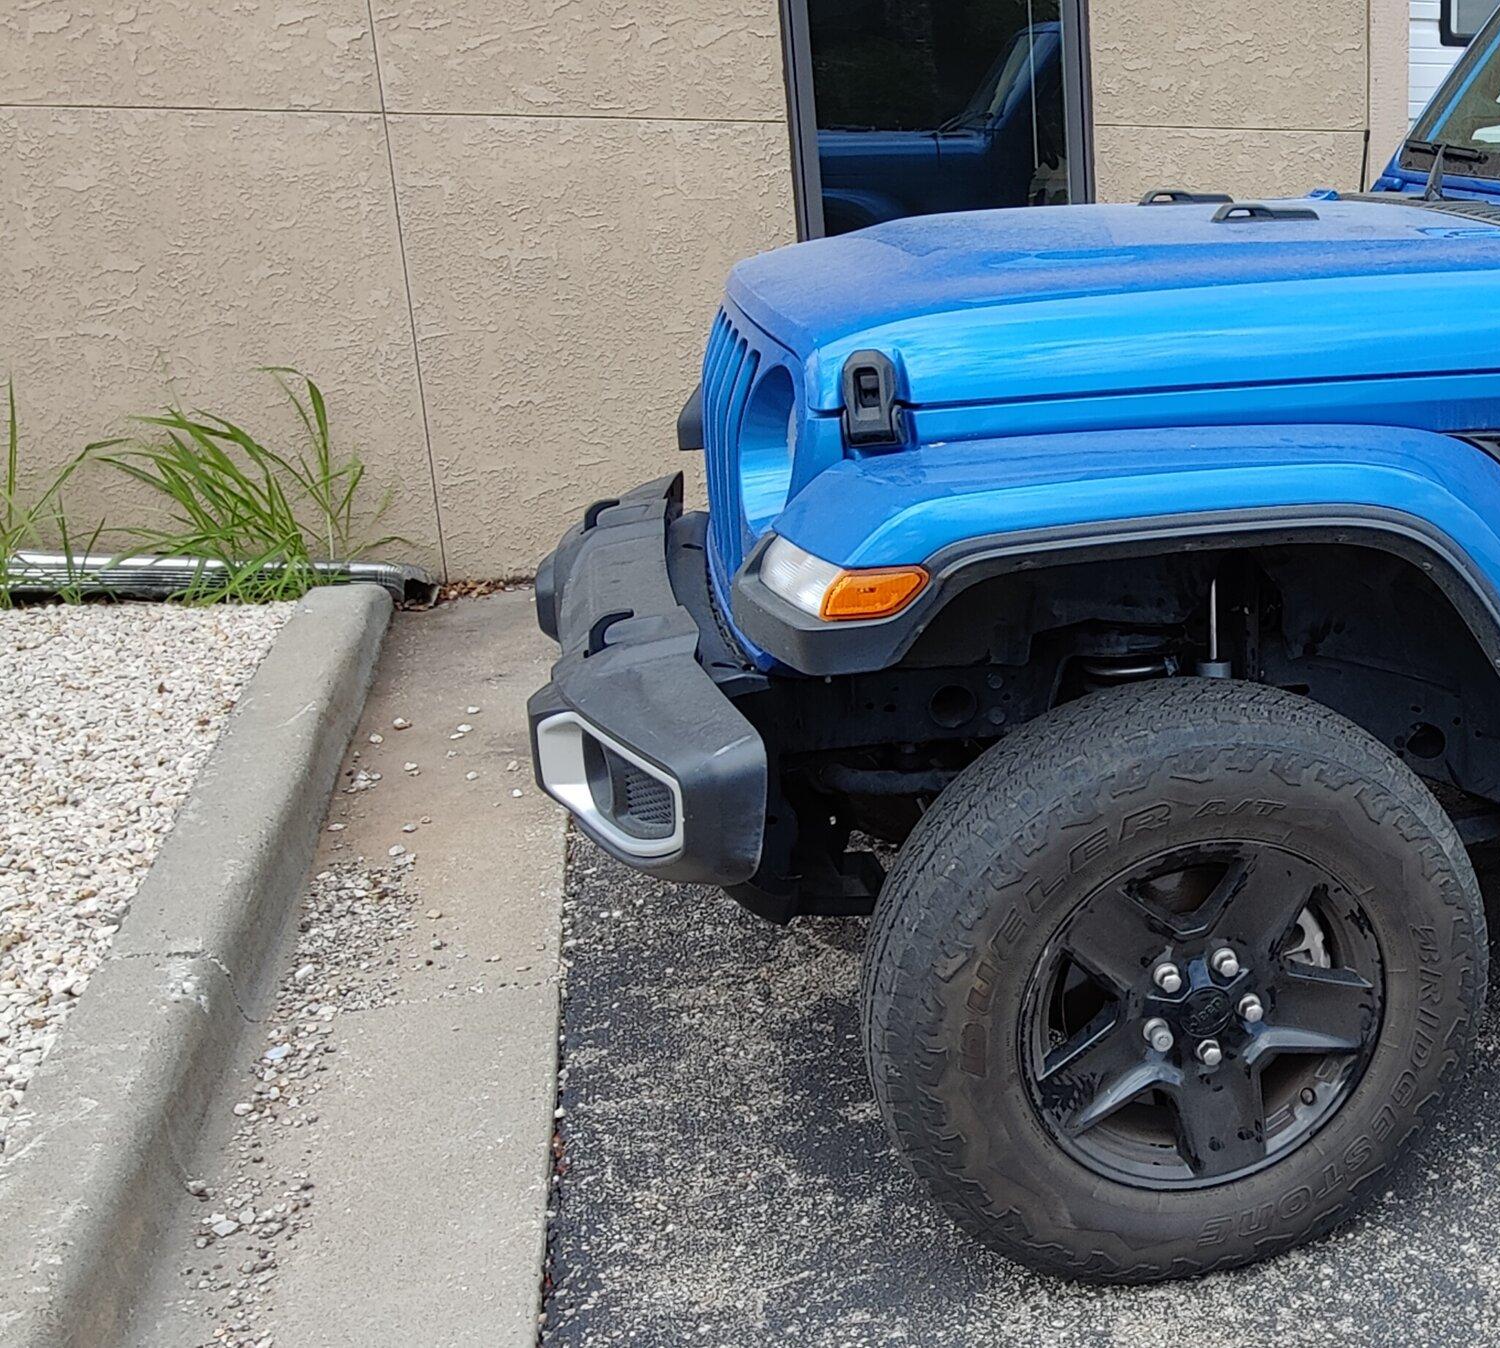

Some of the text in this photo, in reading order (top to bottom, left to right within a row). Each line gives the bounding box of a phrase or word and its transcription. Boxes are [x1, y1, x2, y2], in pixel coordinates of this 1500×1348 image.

[958, 798, 1287, 1079] DUELER A/T
[1187, 995, 1223, 1034] Jeep
[1196, 923, 1444, 1249] BRIDGESTONE
